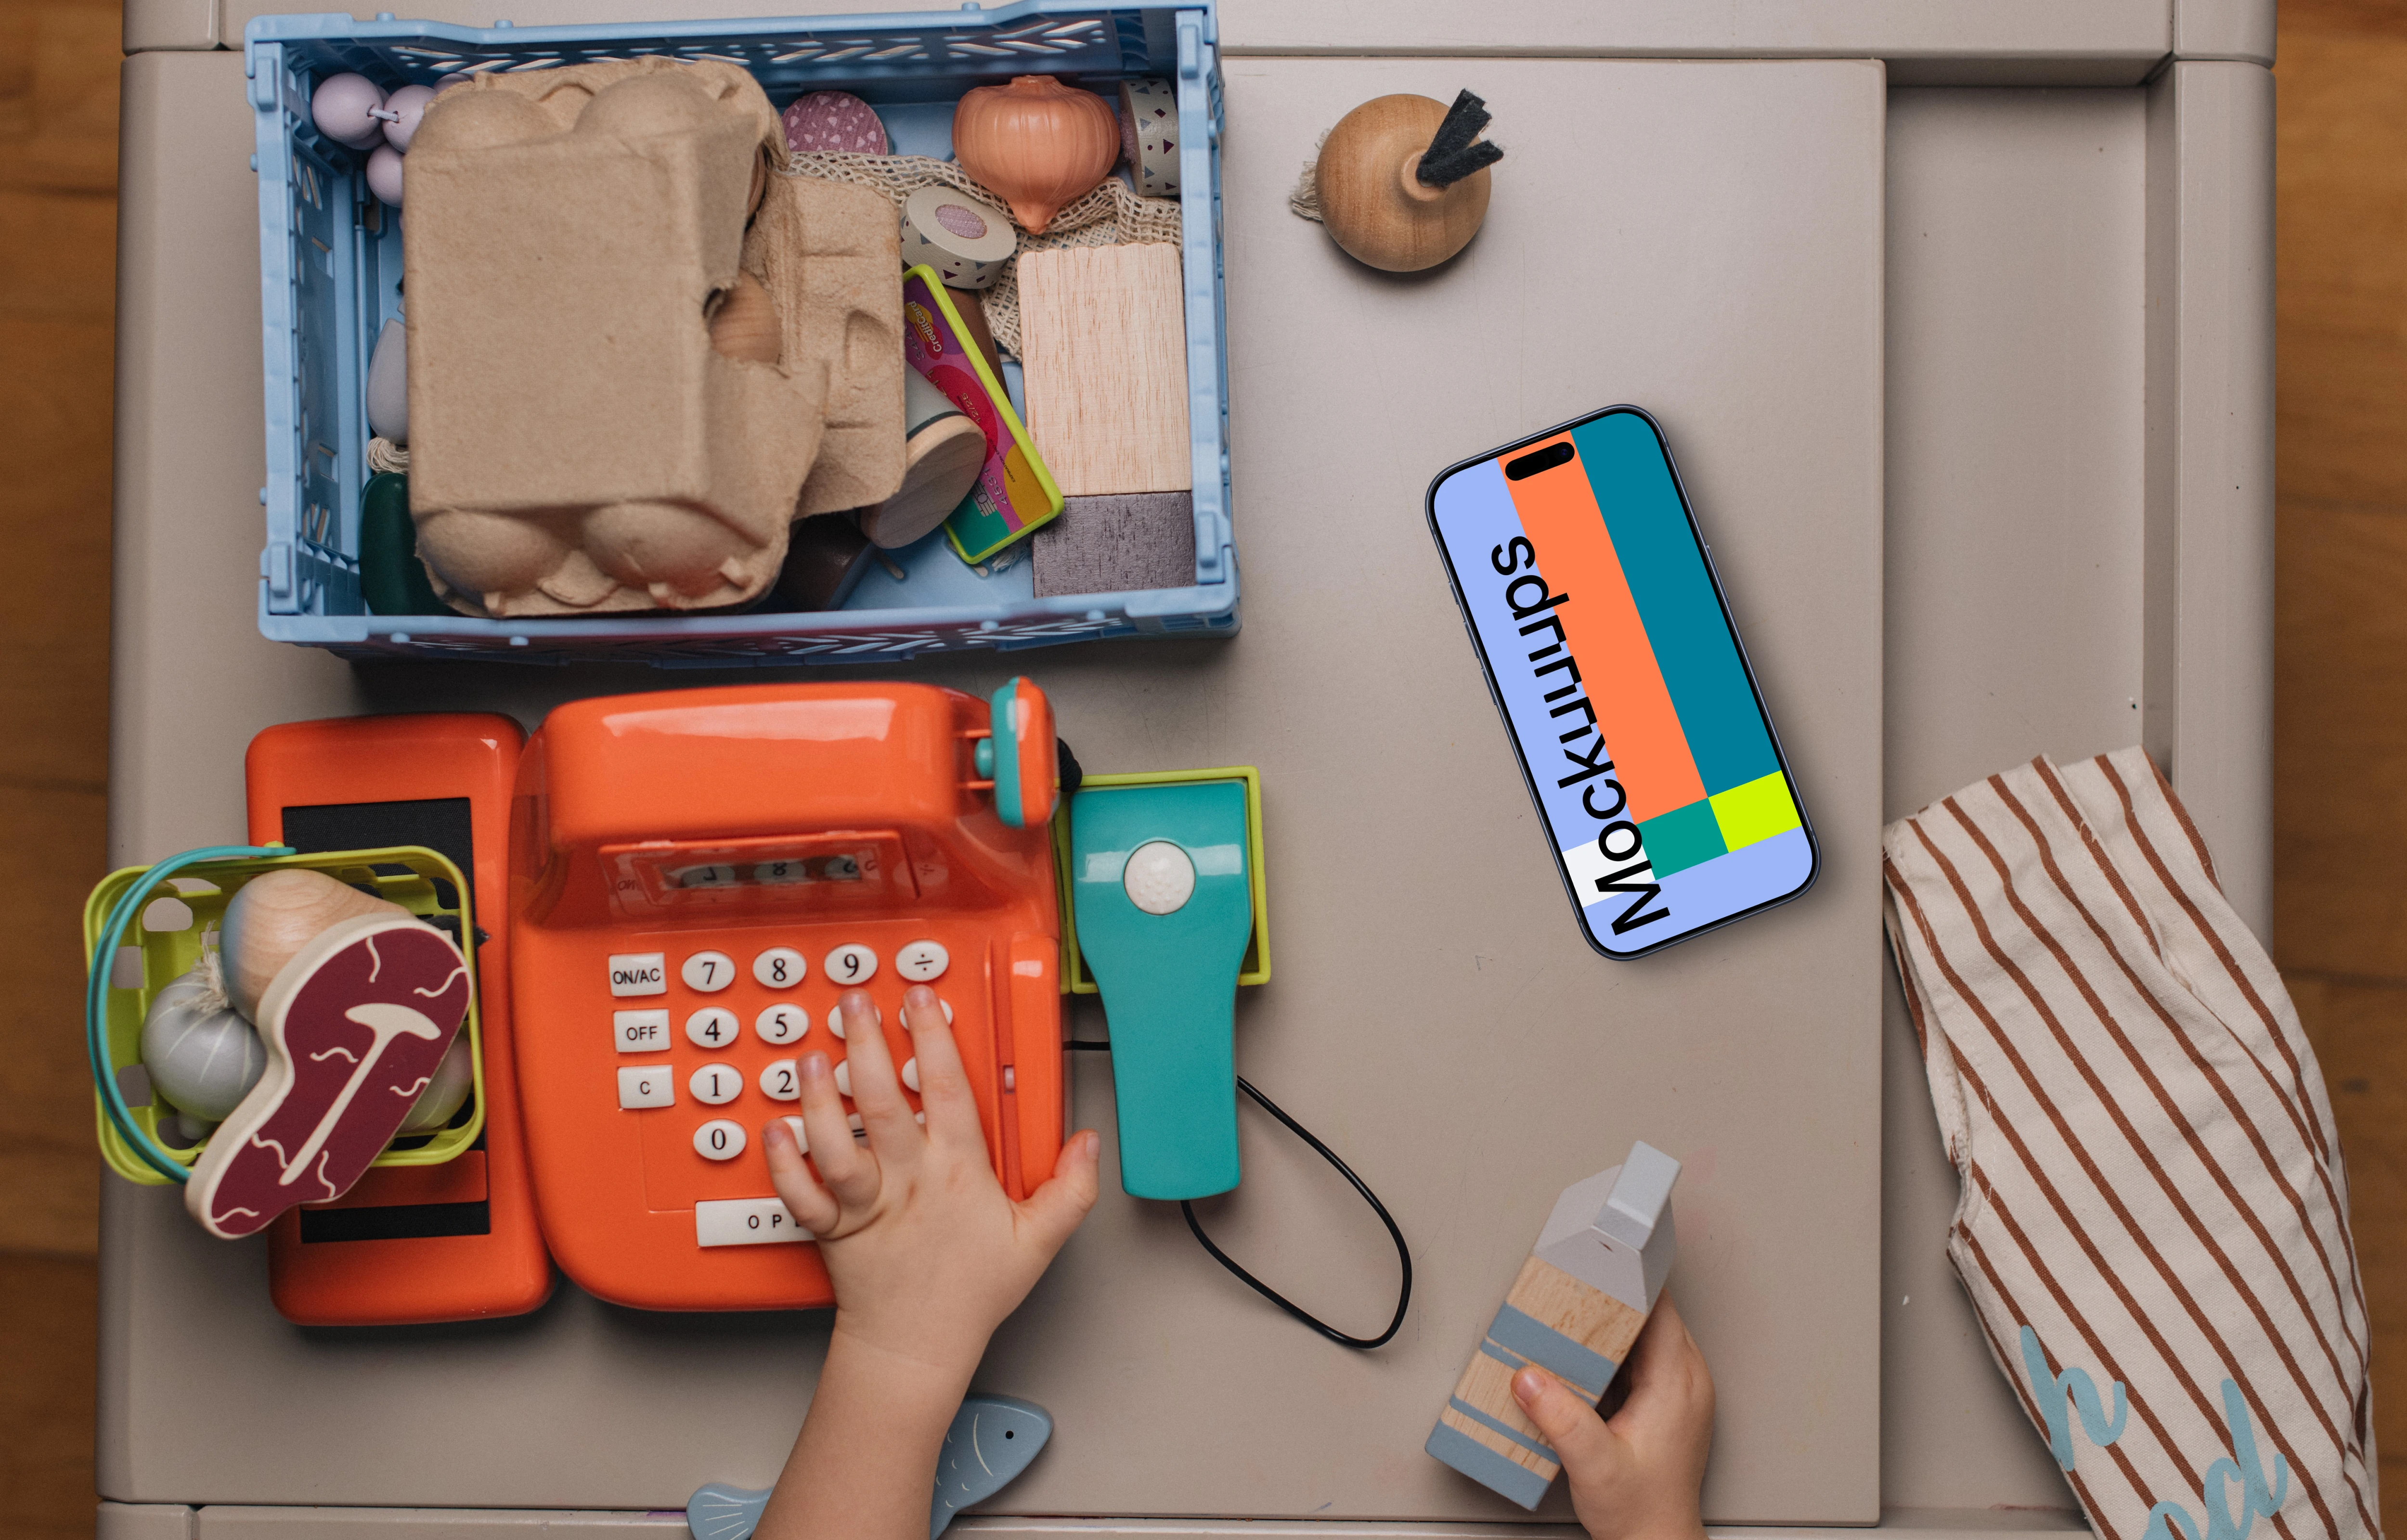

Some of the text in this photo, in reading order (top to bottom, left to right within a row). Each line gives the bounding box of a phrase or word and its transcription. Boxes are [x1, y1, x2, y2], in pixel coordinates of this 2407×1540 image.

[908, 300, 943, 352] CreditCard
[961, 392, 982, 424] 12/25
[982, 467, 1009, 505] 4531
[1491, 535, 1671, 936] Mockuuups
[613, 968, 660, 985] ON/AC
[702, 962, 716, 985] 7
[773, 958, 787, 982] 8
[844, 954, 859, 978] 9
[626, 1026, 658, 1040] OFF
[705, 1018, 721, 1041] 4
[776, 1014, 788, 1038] 5
[640, 1081, 651, 1095] C
[712, 1073, 720, 1096] 1
[778, 1070, 794, 1093] 2
[712, 1129, 726, 1150] 0
